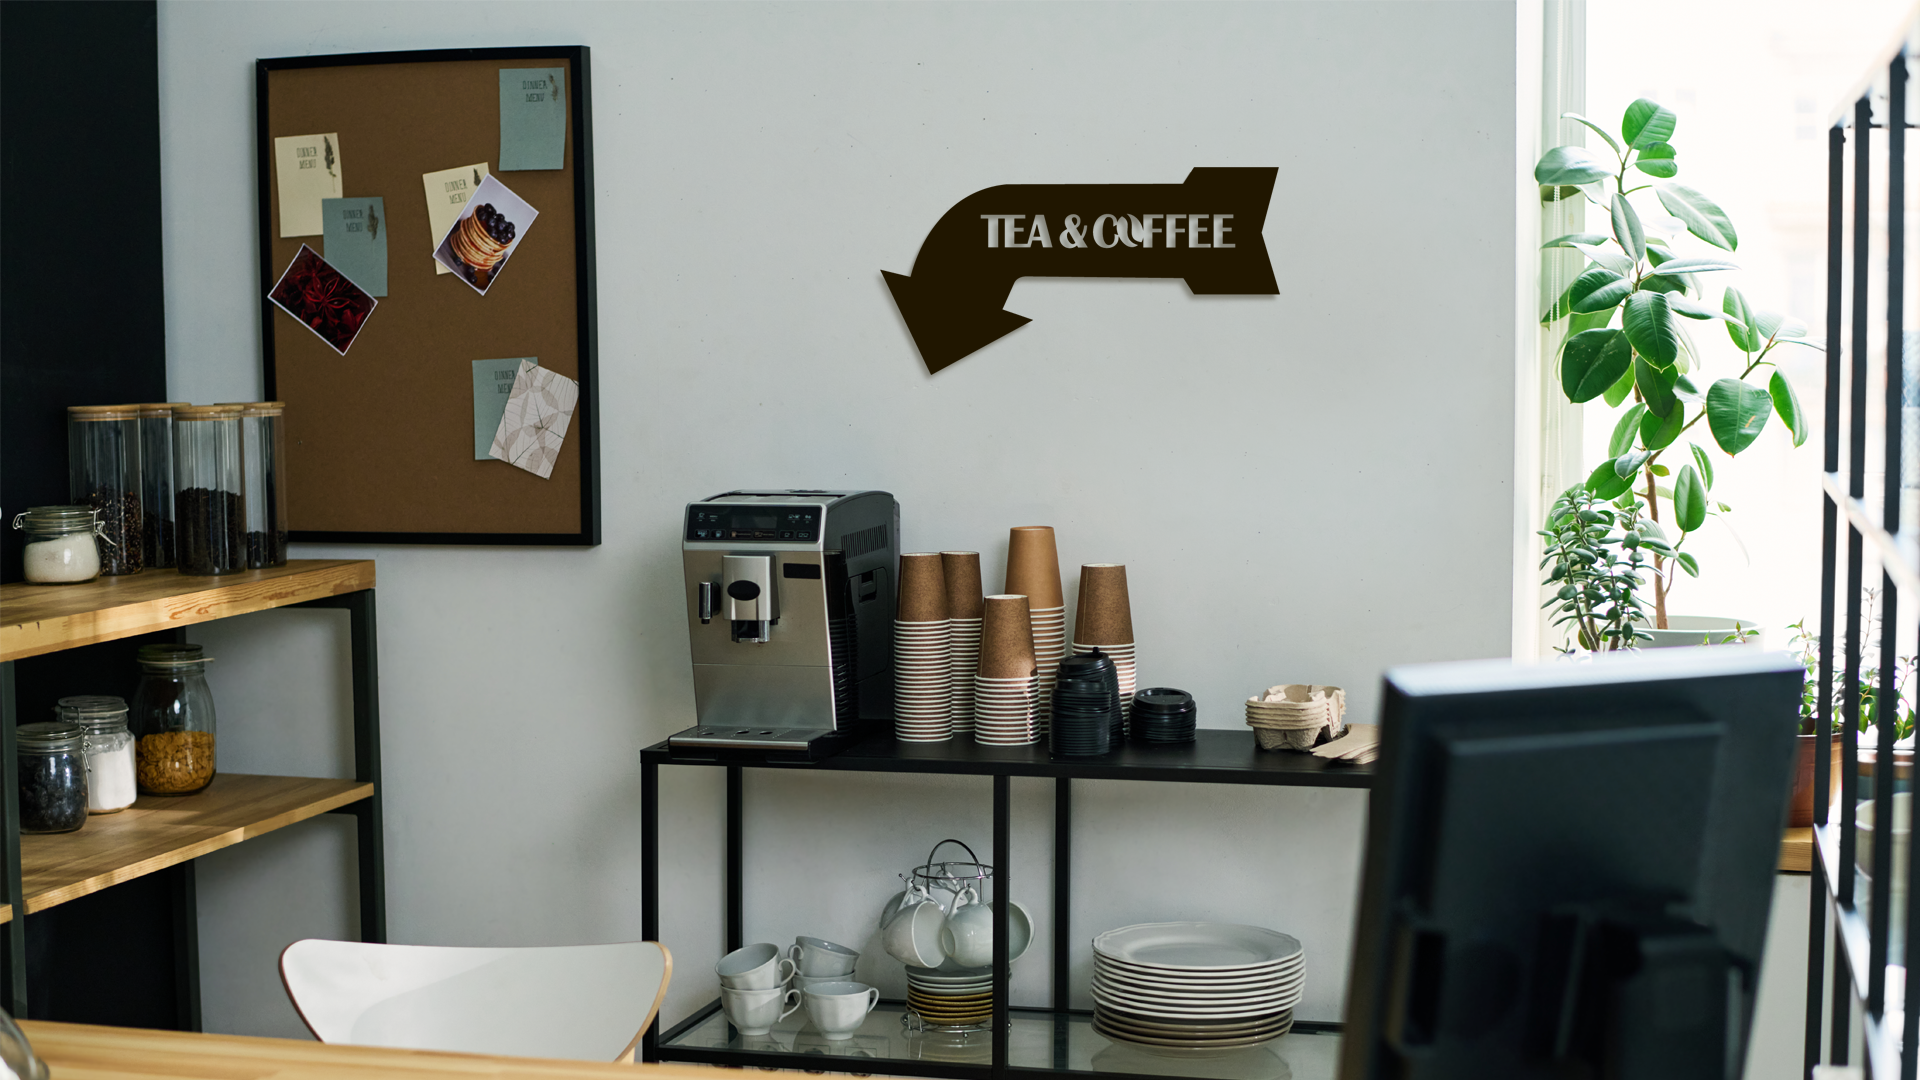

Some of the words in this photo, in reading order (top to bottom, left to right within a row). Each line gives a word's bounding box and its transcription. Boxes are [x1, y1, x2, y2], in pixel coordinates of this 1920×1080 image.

[522, 80, 548, 90] DINNER
[525, 93, 545, 103] MENU
[444, 179, 468, 193] DINNER
[449, 192, 467, 205] MENU
[980, 214, 1053, 248] TEA
[1059, 213, 1088, 249] &
[1092, 213, 1236, 249] COFFEE
[497, 383, 514, 394] MEN
